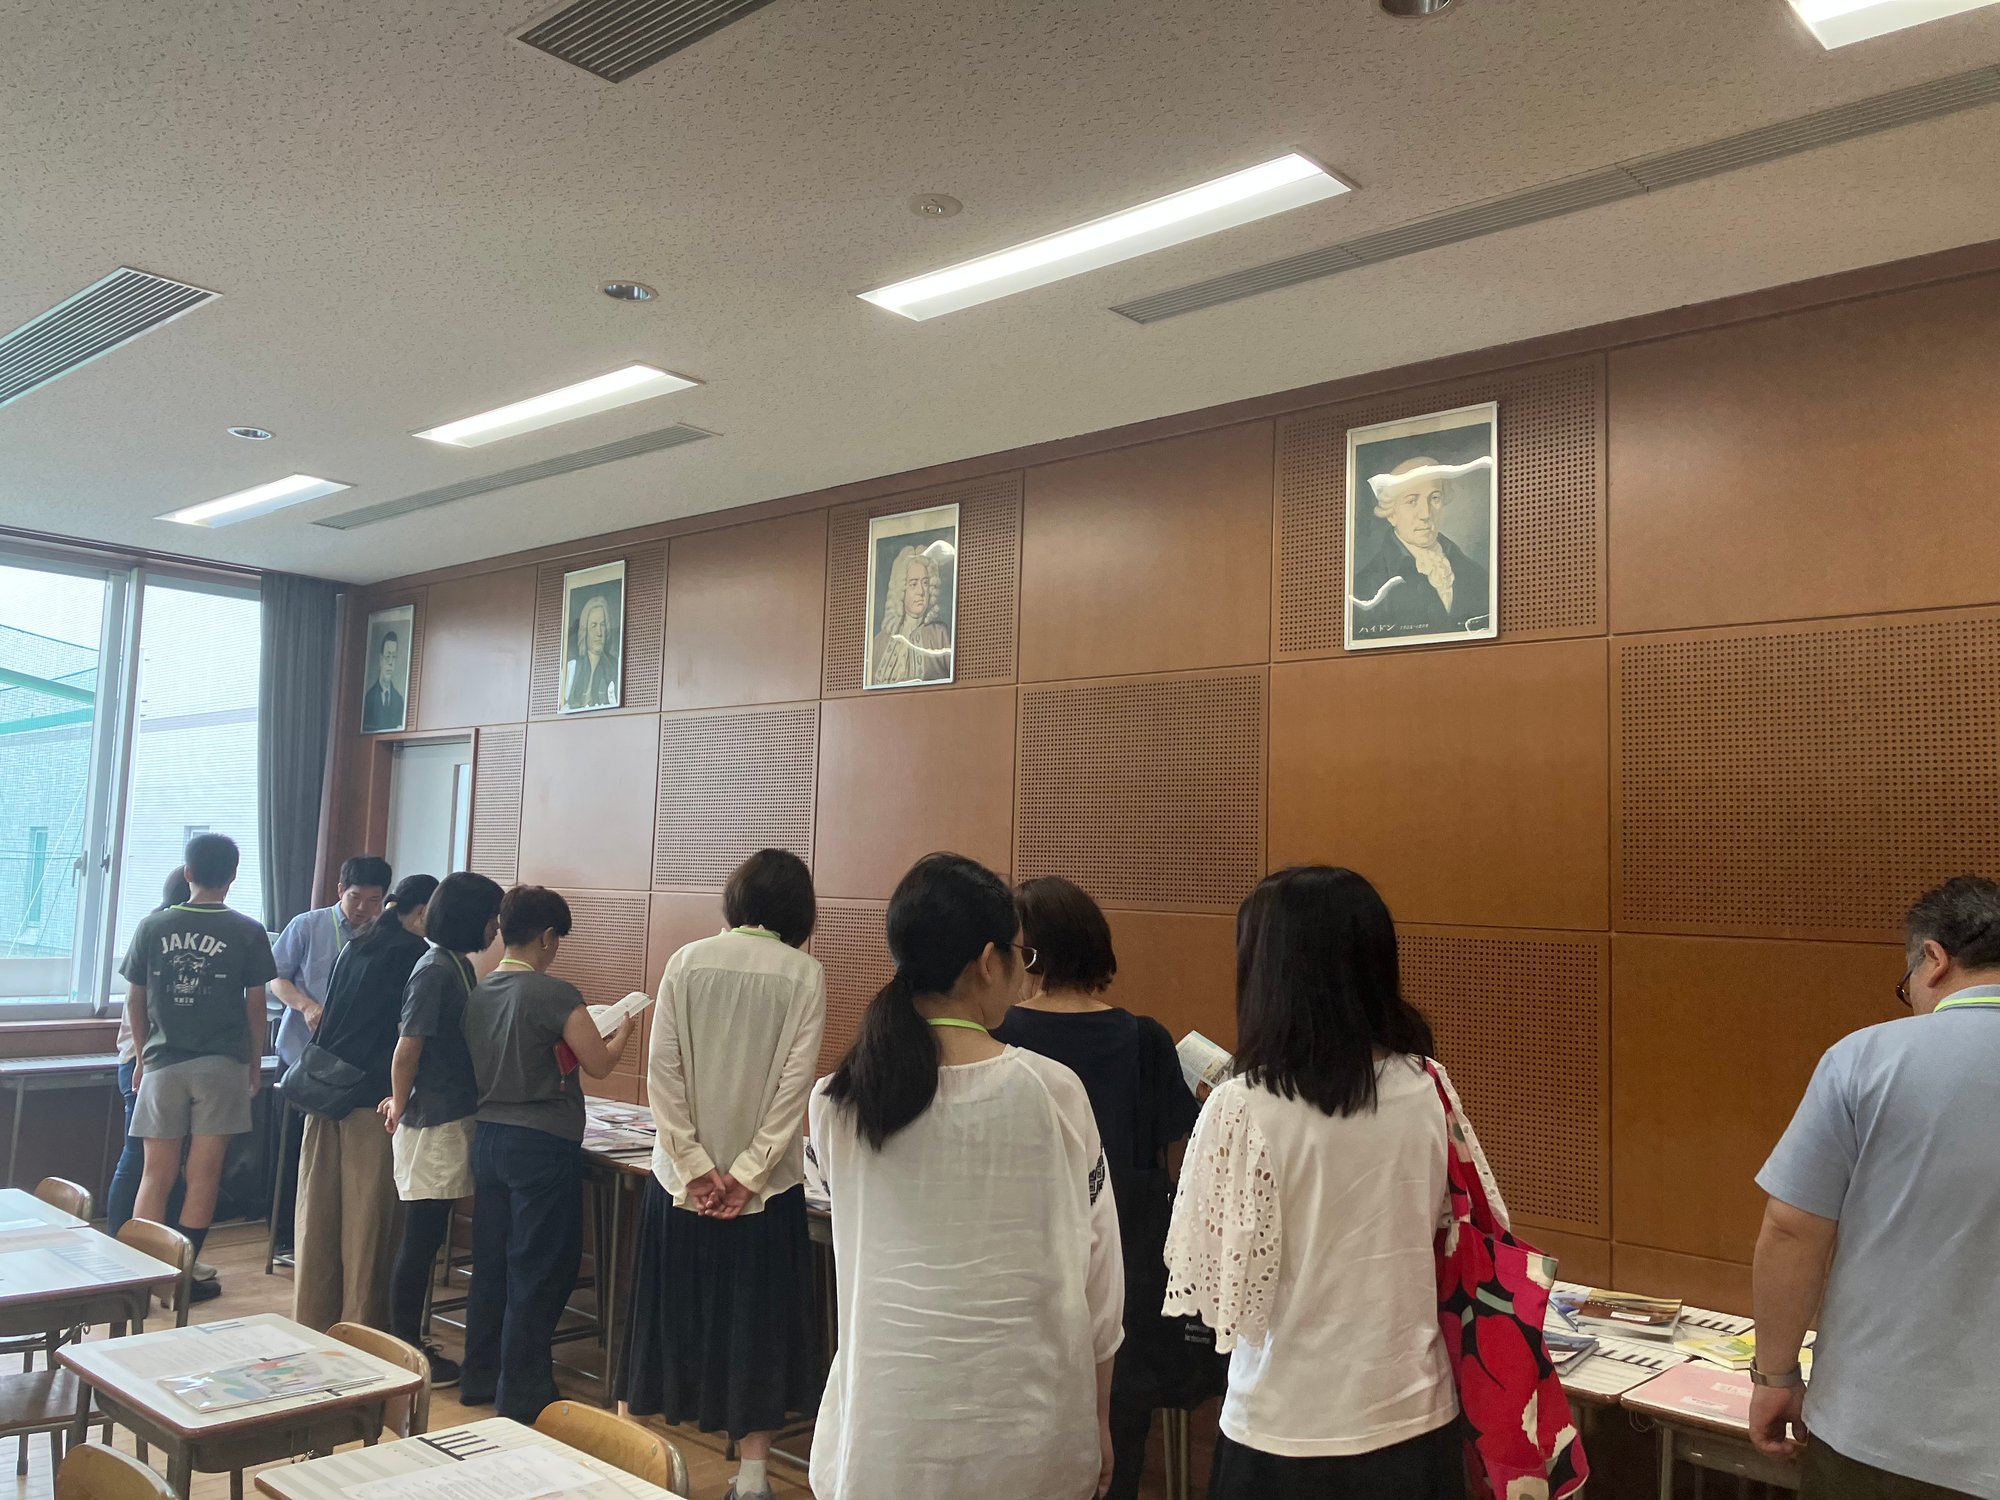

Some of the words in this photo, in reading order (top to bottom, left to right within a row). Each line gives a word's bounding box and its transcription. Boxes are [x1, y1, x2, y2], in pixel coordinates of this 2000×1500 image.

[1358, 624, 1396, 634] ハイドン
[161, 932, 227, 956] JAKDF
